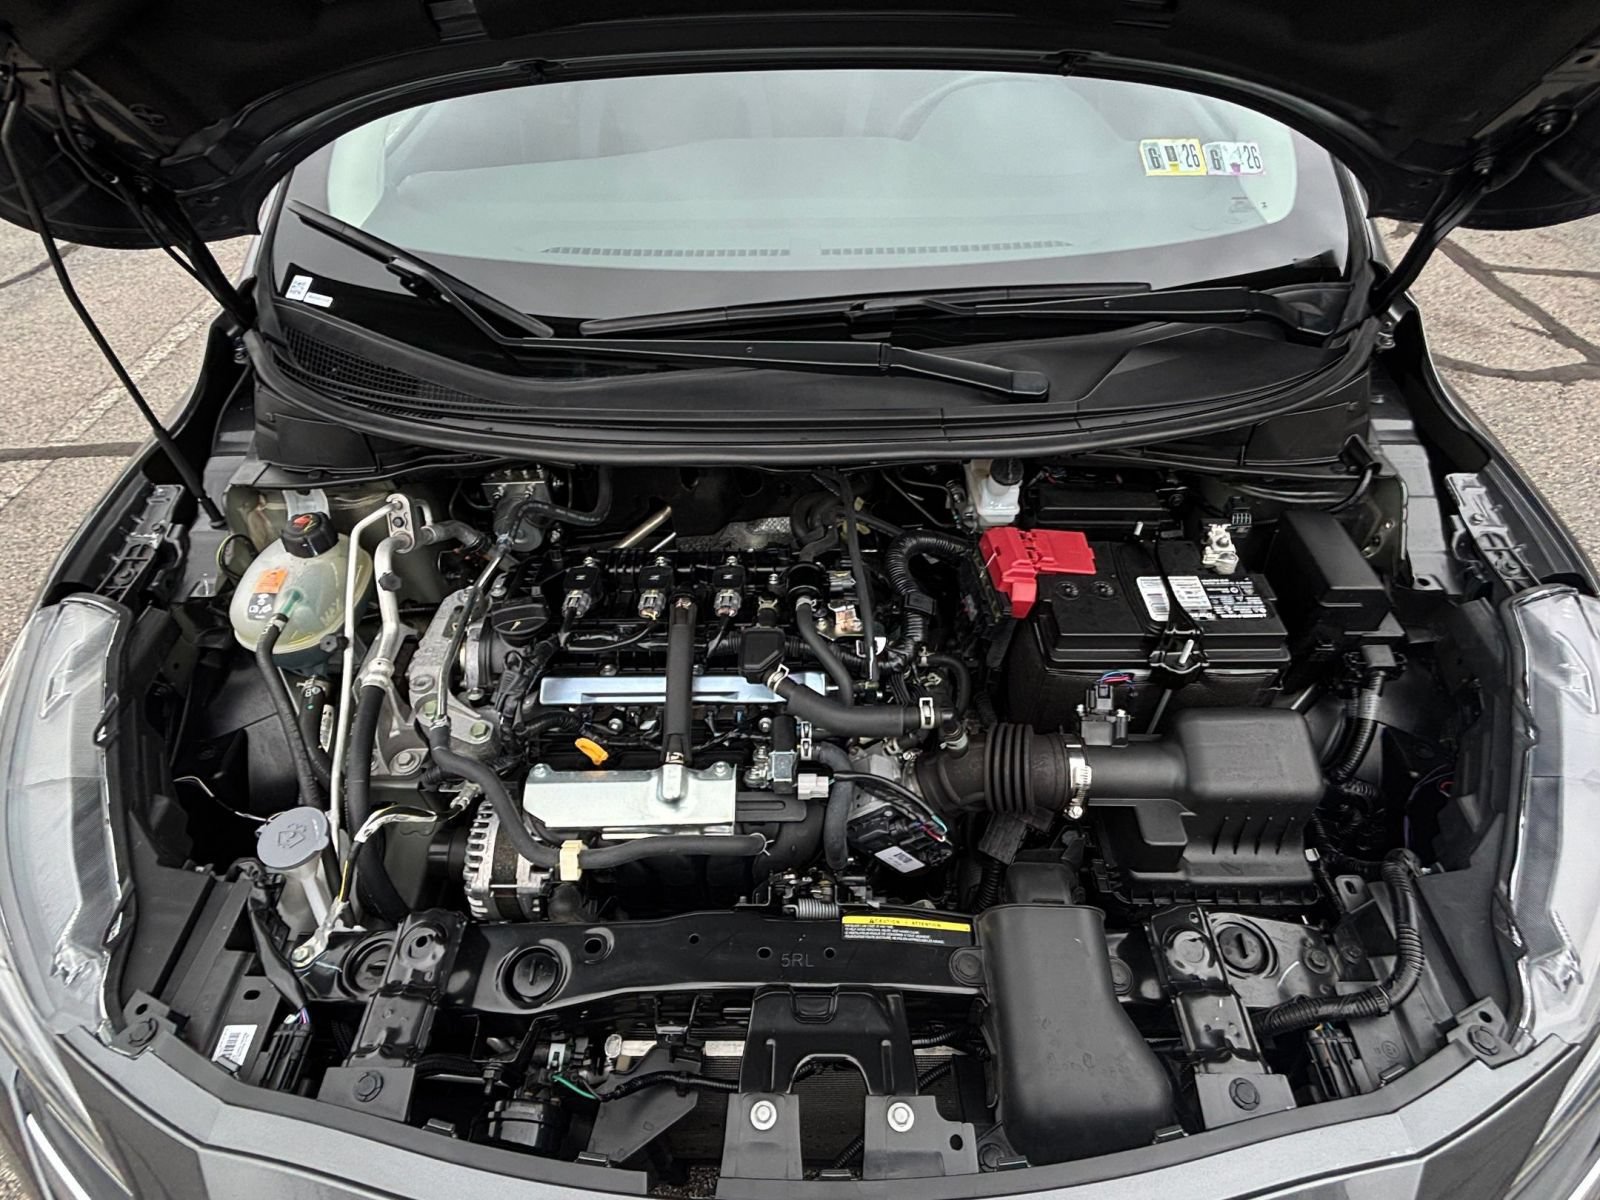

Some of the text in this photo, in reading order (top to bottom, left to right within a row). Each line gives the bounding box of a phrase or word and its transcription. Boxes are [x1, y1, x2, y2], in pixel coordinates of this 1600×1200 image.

[1182, 143, 1200, 168] 26
[1243, 145, 1261, 169] 26
[781, 953, 815, 968] 5RL
